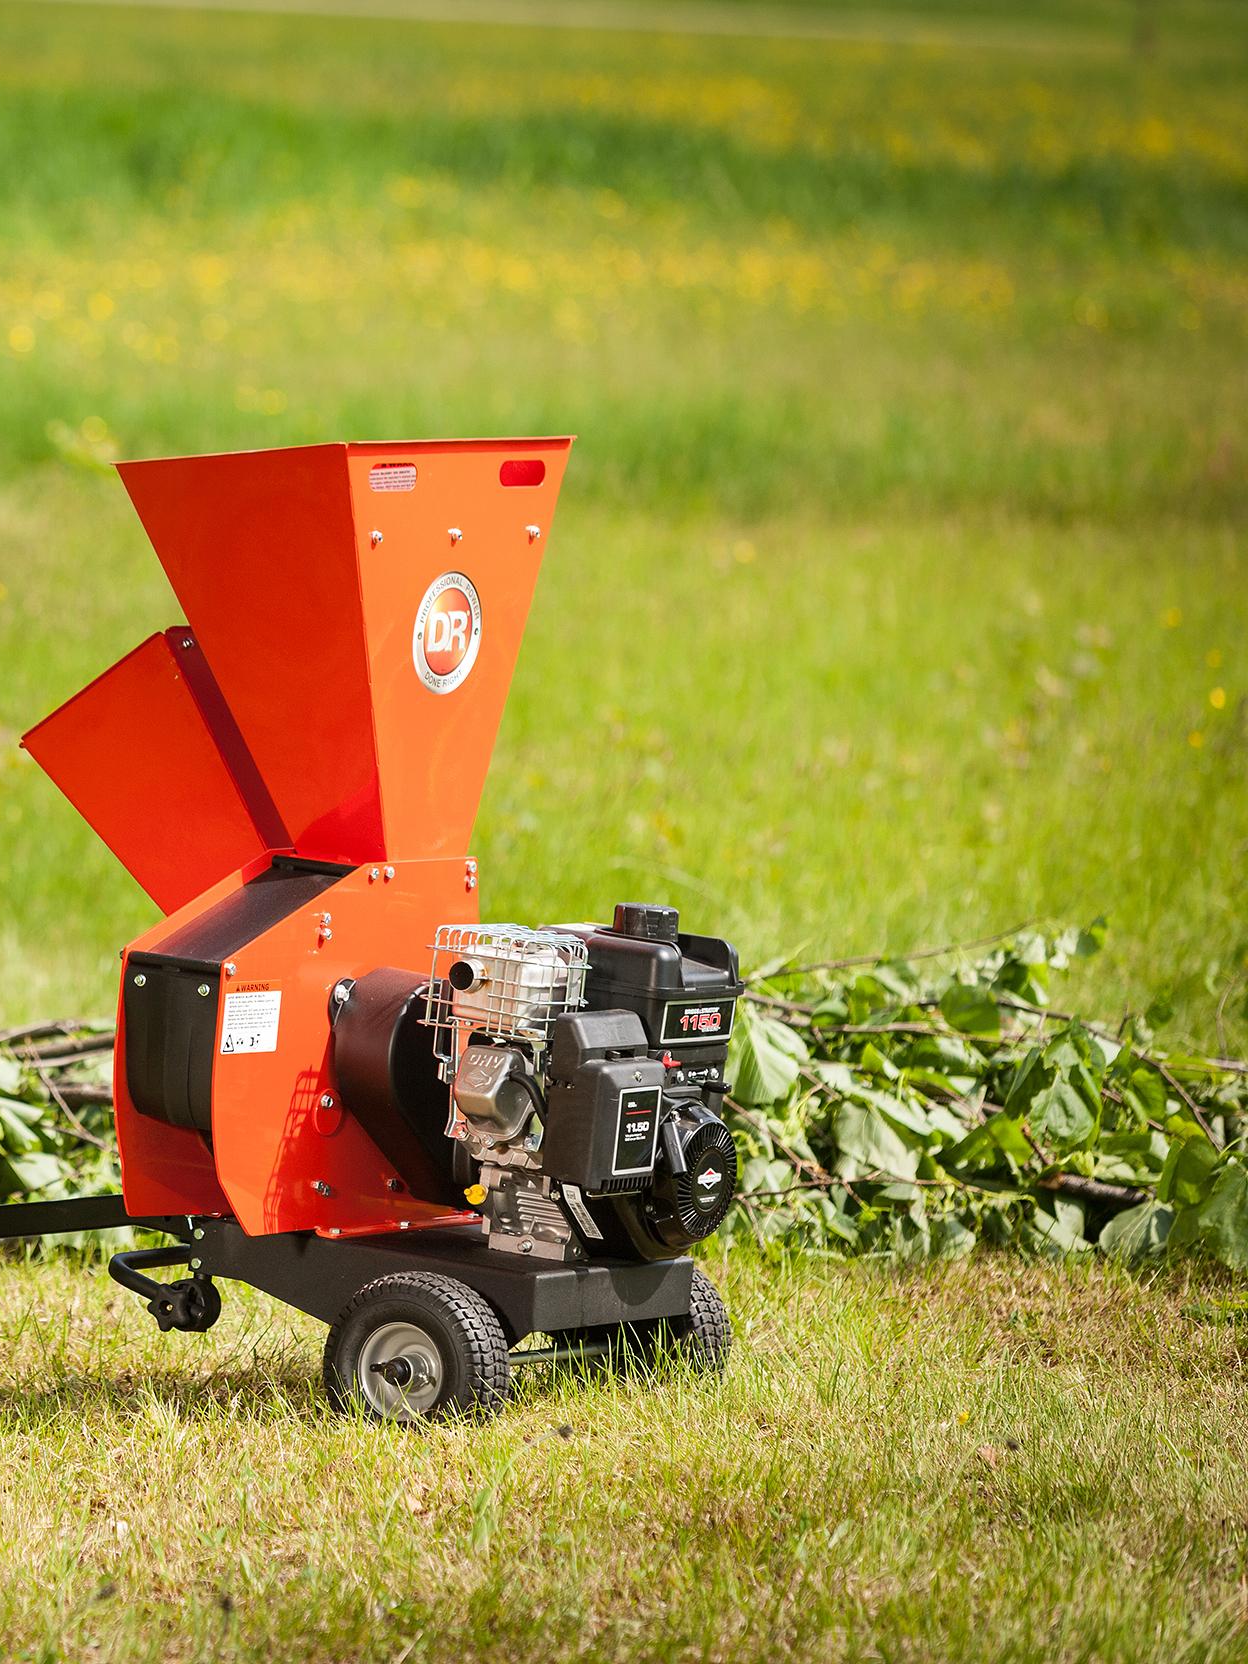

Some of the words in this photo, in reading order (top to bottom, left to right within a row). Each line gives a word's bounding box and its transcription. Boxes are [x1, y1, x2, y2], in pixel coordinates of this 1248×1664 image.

[420, 576, 463, 624] PROFESSIONAL
[466, 584, 480, 620] POWER
[425, 671, 441, 688] DONE
[442, 670, 462, 687] RIGHT
[241, 983, 270, 992] WARNING
[680, 1012, 722, 1032] 1150
[466, 1054, 505, 1069] OHV
[626, 1121, 650, 1134] 11.50
